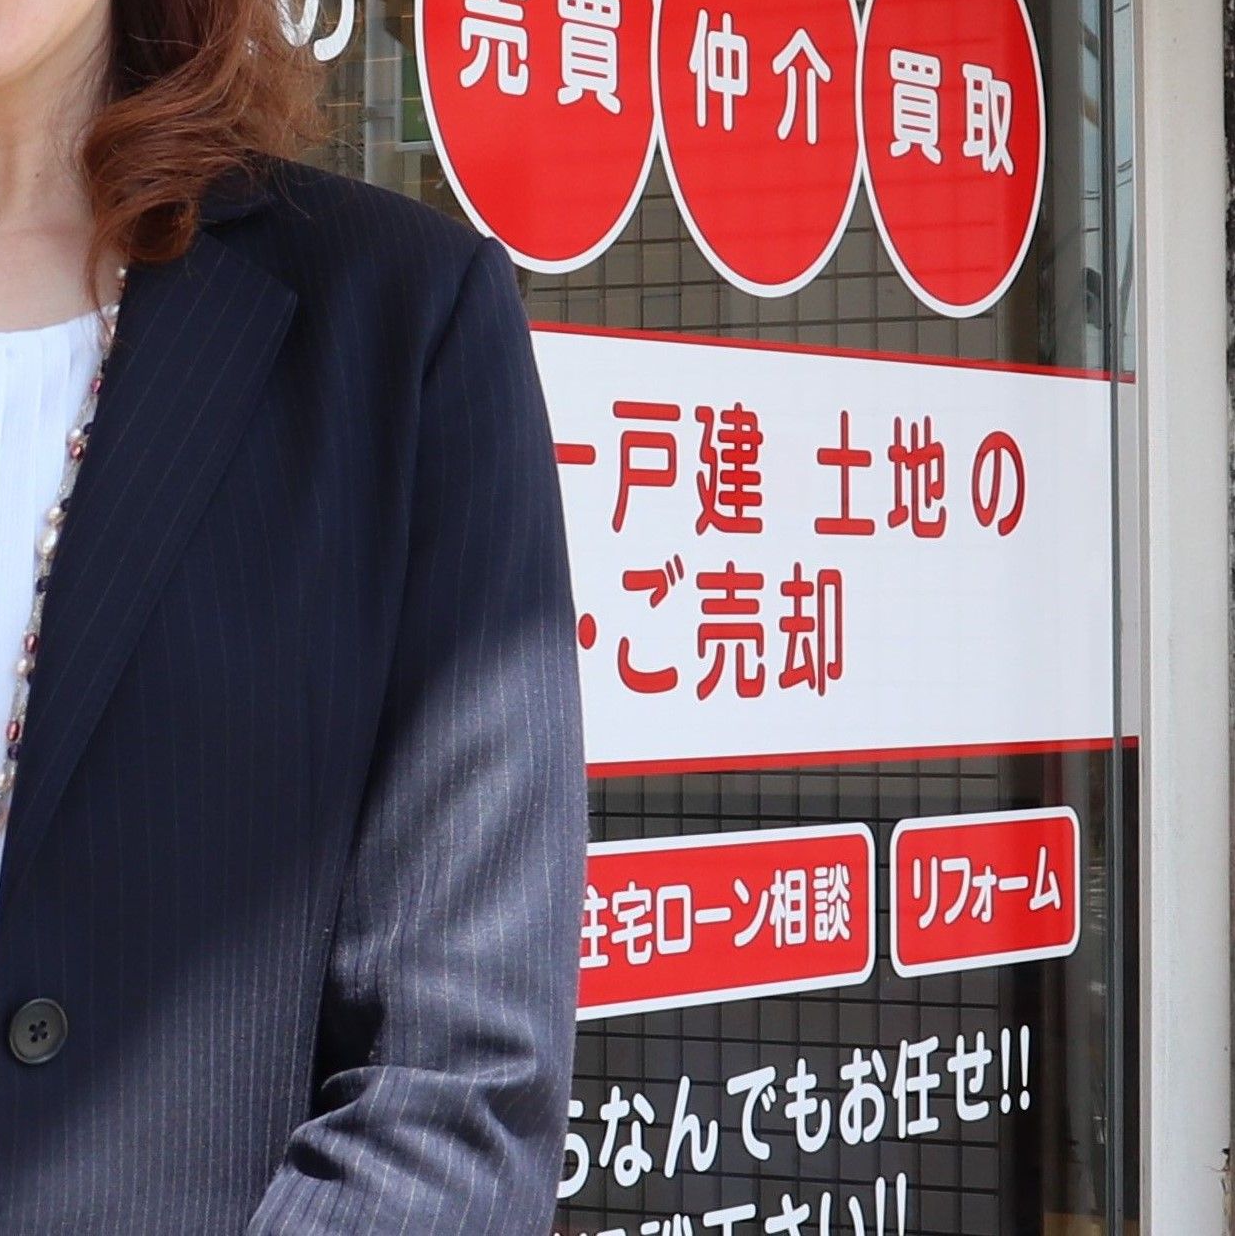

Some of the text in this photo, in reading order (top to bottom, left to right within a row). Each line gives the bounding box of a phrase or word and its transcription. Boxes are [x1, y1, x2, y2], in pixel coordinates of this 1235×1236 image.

[689, 8, 831, 144] 仲介
[889, 48, 1014, 178] 買取
[912, 846, 1061, 929] リフォーム
